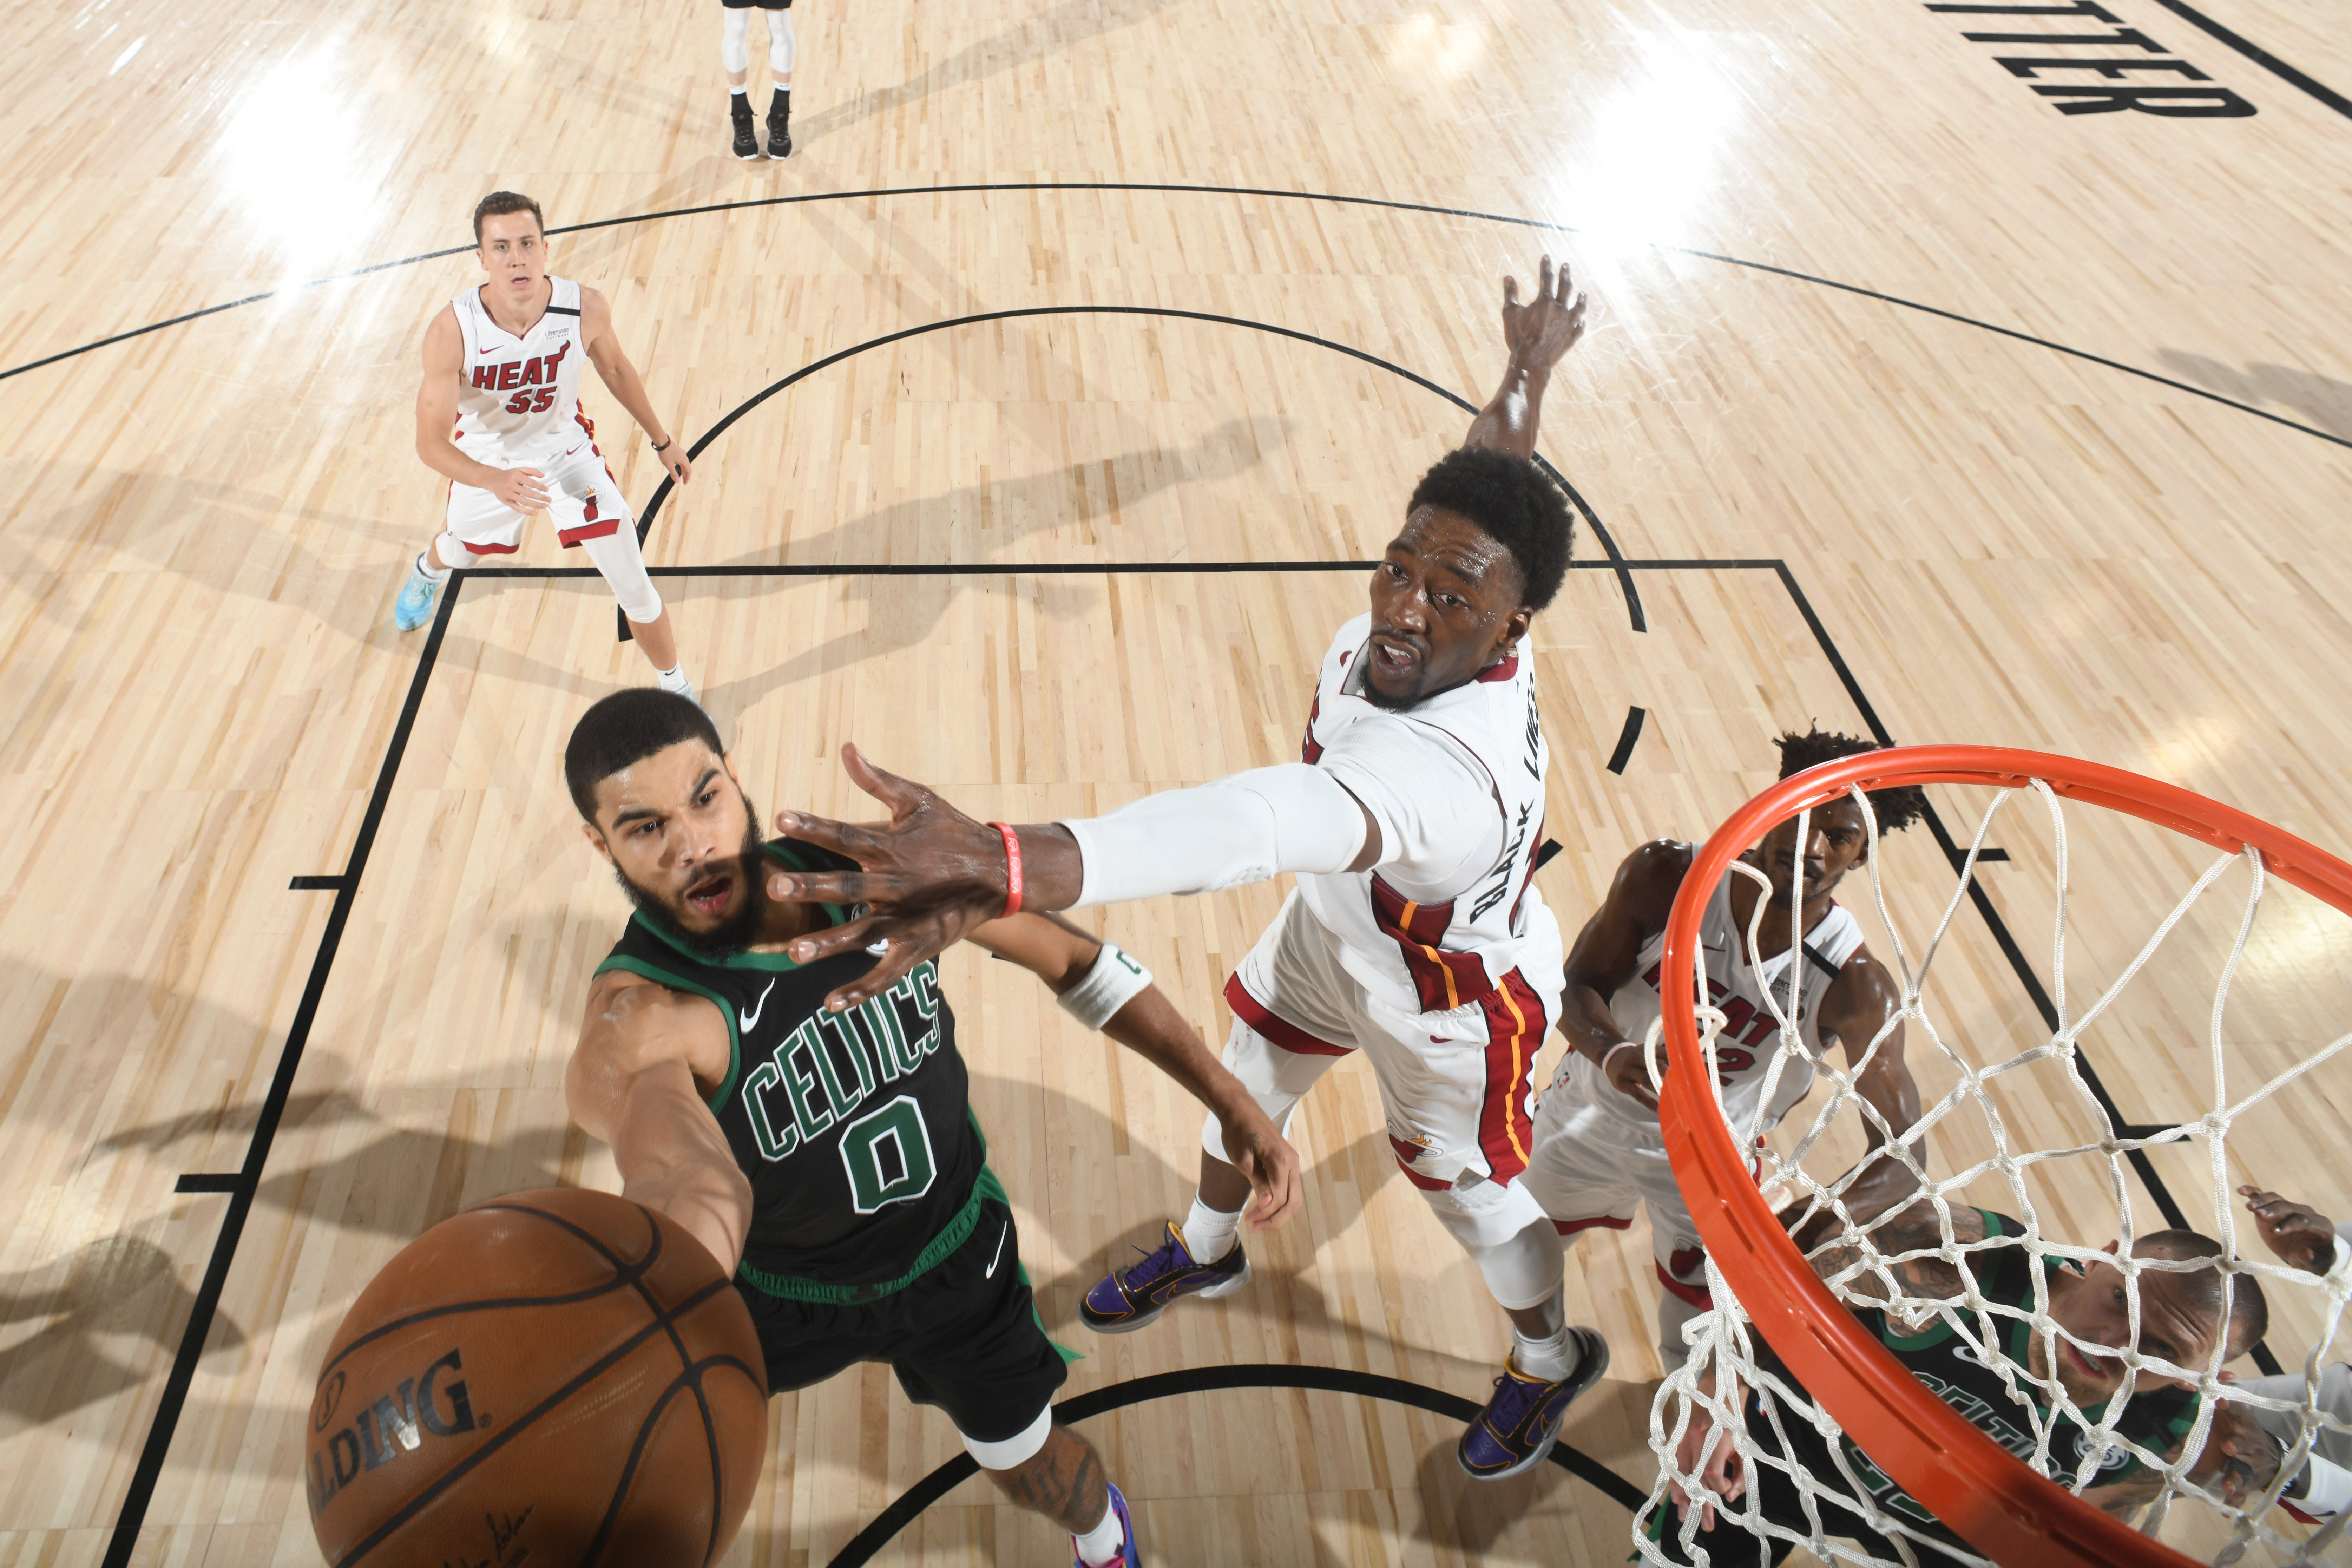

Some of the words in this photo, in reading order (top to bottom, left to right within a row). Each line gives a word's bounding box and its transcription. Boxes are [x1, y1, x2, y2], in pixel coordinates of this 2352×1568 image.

[472, 339, 570, 391] HEAT
[545, 328, 569, 337] Ultimate
[505, 386, 558, 414] 55
[1470, 799, 1535, 925] BLACK
[741, 959, 941, 1162] CELTICS
[838, 1094, 937, 1215] 0
